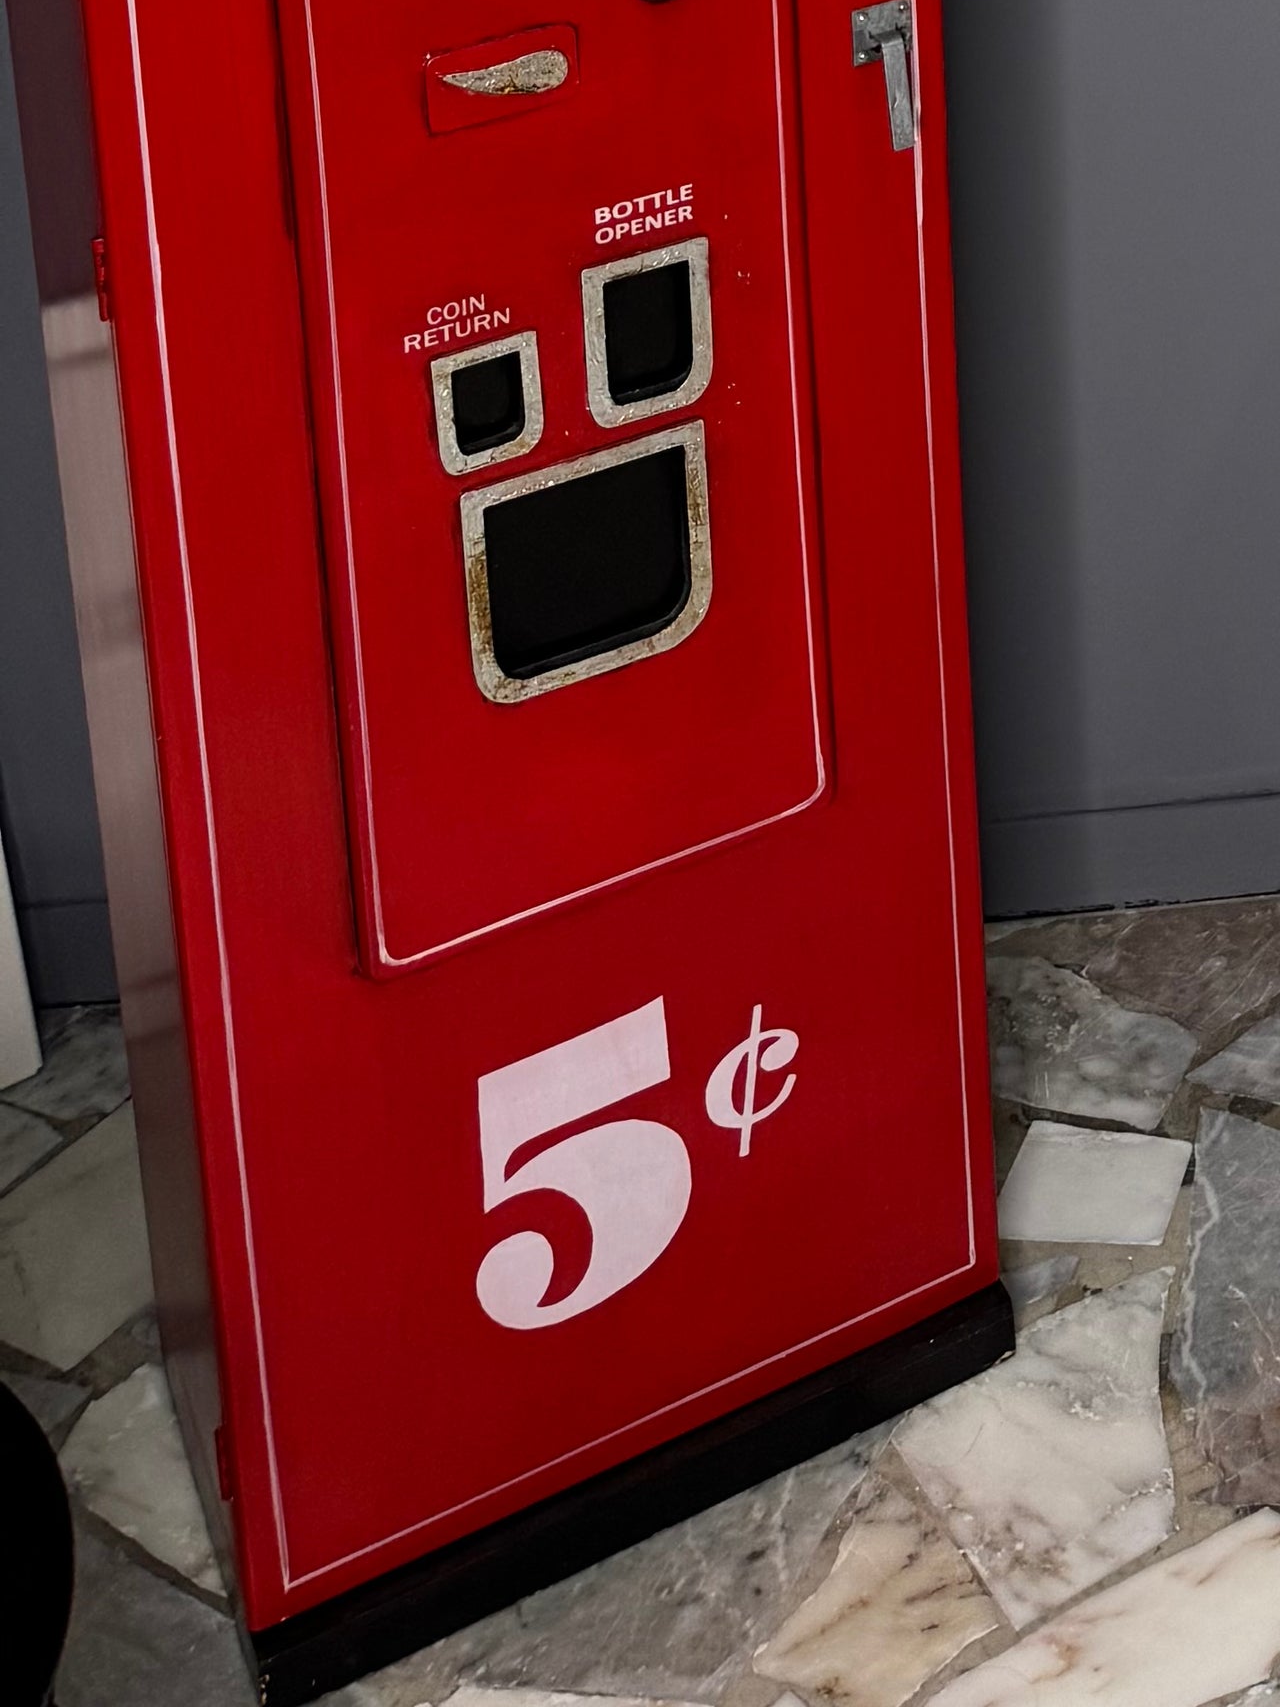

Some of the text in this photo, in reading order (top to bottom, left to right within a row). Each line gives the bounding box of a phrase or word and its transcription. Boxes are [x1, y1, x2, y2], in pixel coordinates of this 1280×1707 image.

[595, 184, 694, 225] BOTTLE
[595, 206, 694, 244] OPENER
[426, 294, 485, 325] COIN
[403, 308, 511, 354] RETURN
[476, 995, 800, 1330] 5¢
